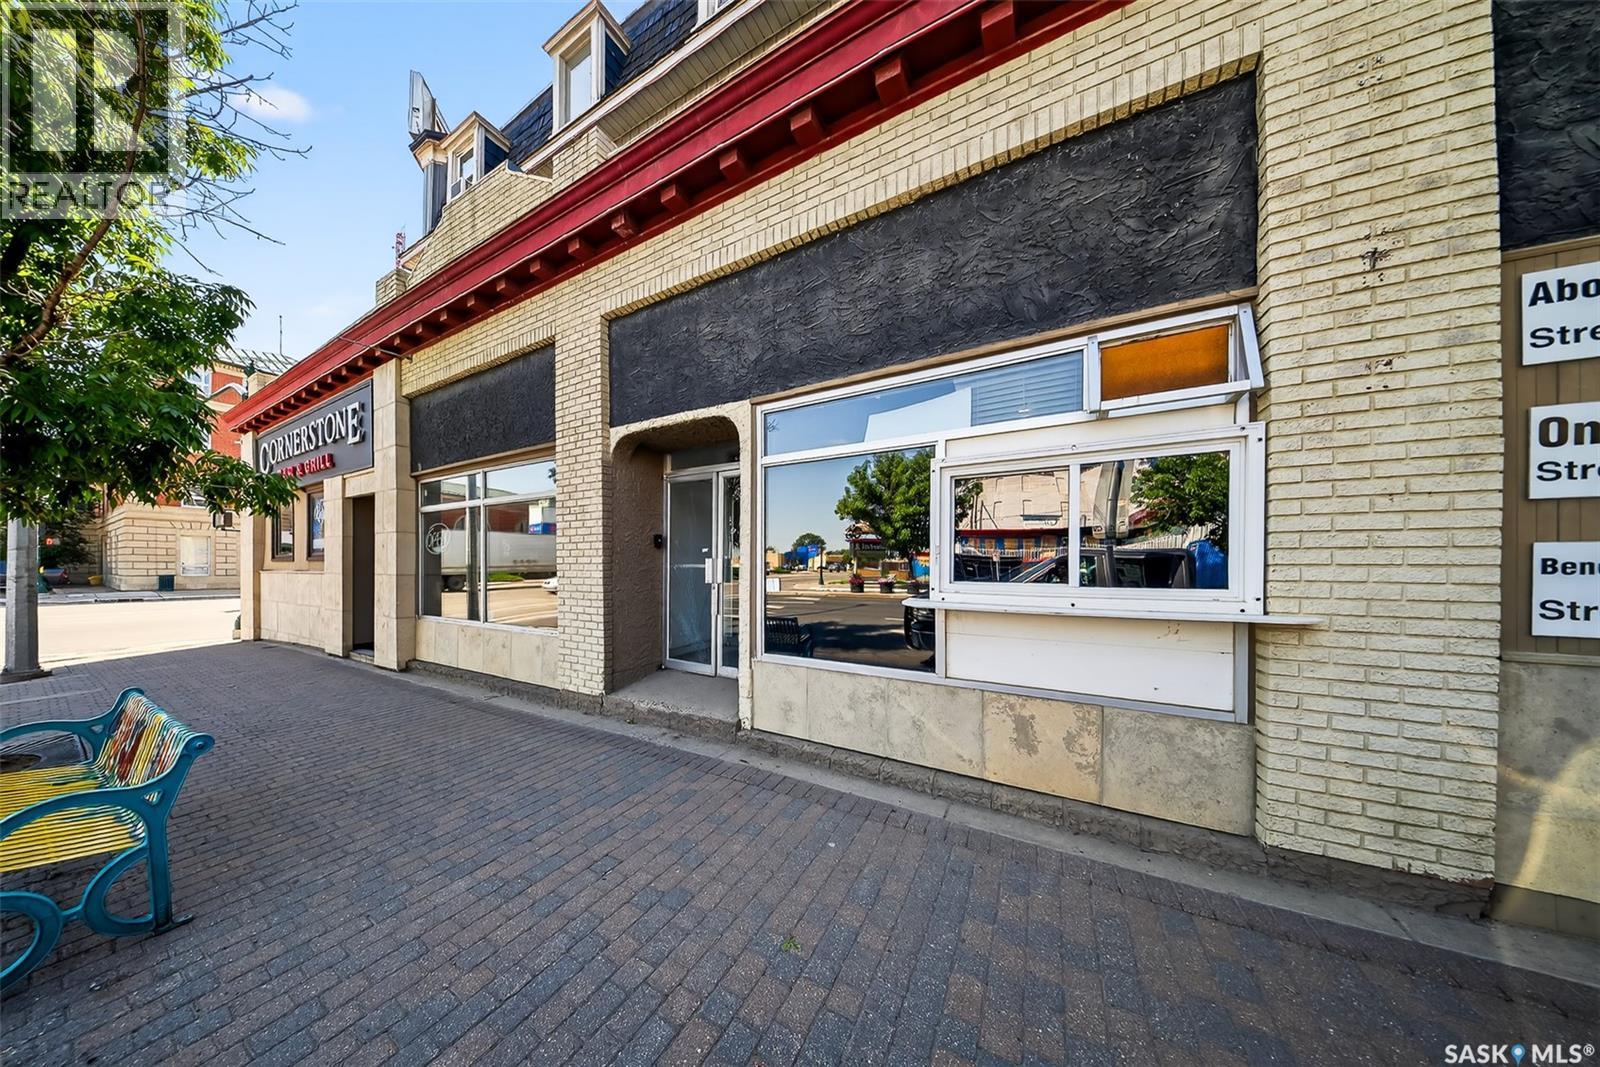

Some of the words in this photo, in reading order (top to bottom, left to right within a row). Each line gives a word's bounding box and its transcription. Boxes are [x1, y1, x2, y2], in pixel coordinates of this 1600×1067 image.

[1528, 278, 1600, 307] Abo
[260, 402, 363, 474] CORNERSTONE
[1539, 416, 1600, 448] On
[304, 453, 334, 473] GRILL
[1536, 461, 1600, 482] Str
[1541, 558, 1600, 575] Ben
